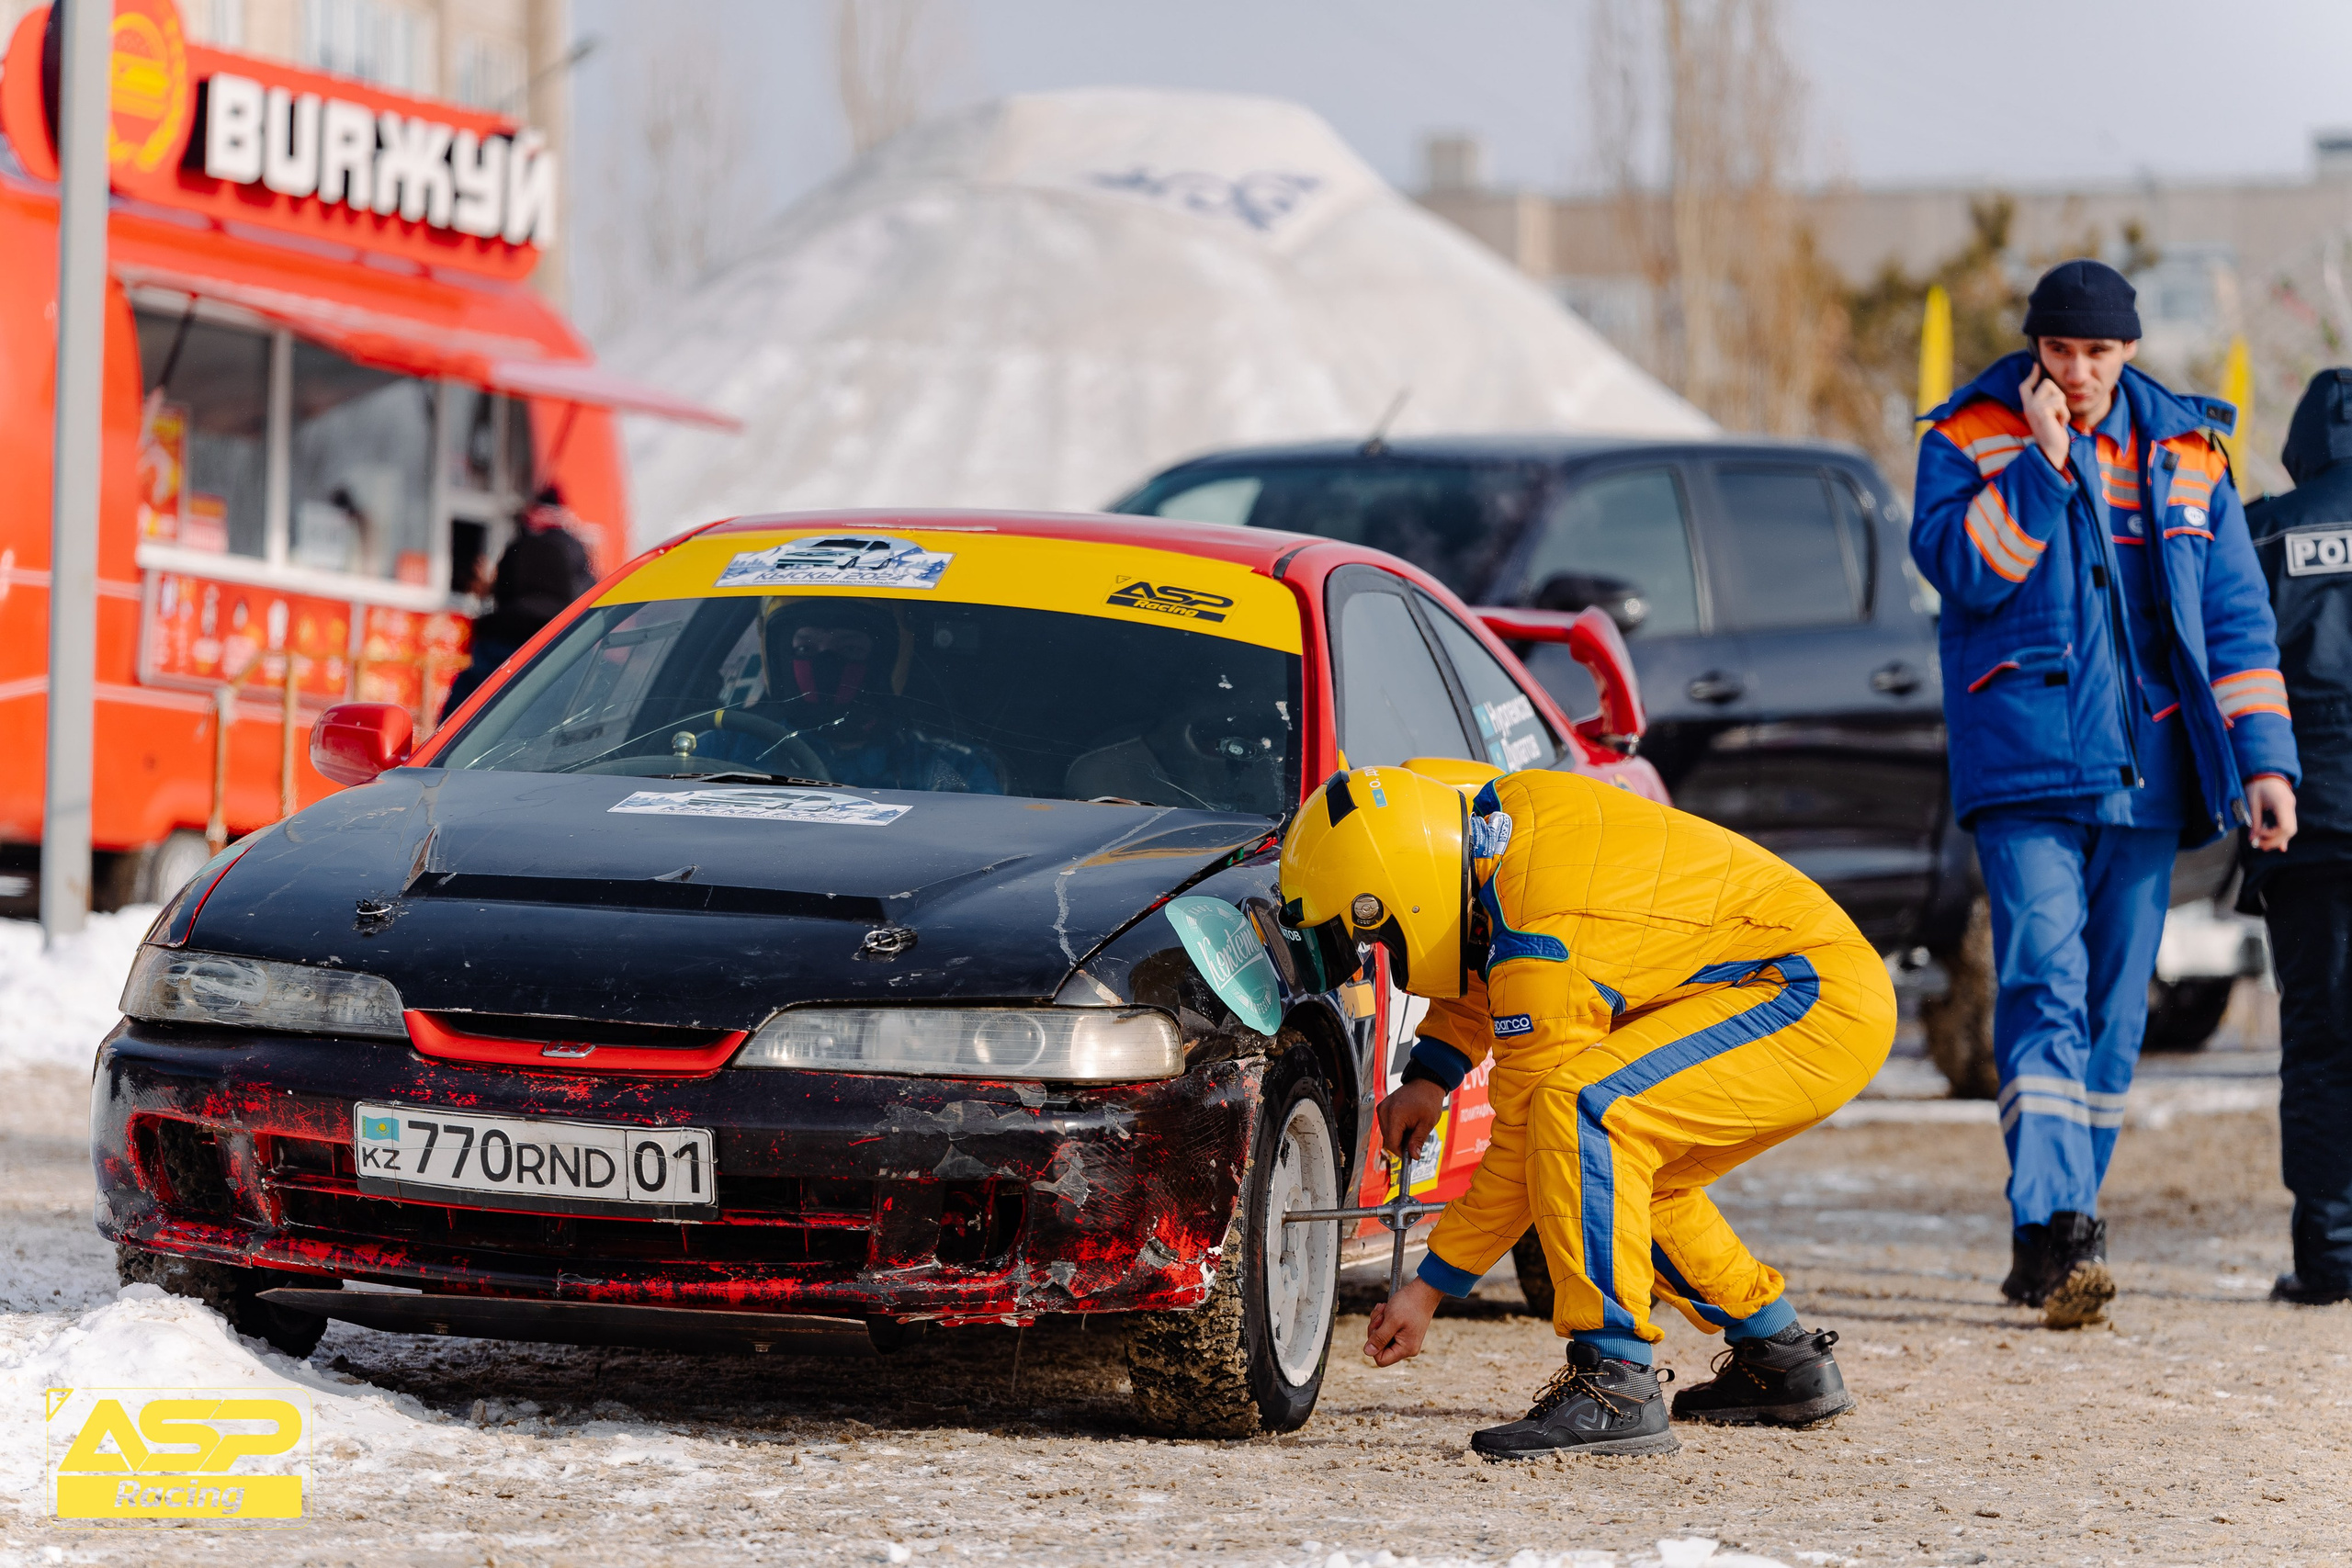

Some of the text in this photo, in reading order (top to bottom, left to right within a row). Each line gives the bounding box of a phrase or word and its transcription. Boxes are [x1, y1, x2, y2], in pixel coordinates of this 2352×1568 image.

[843, 571, 908, 581] 2024
[1113, 581, 1234, 609] ASP
[1133, 599, 1199, 618] Racing
[362, 1146, 401, 1171] KZ
[634, 1141, 700, 1193] 01
